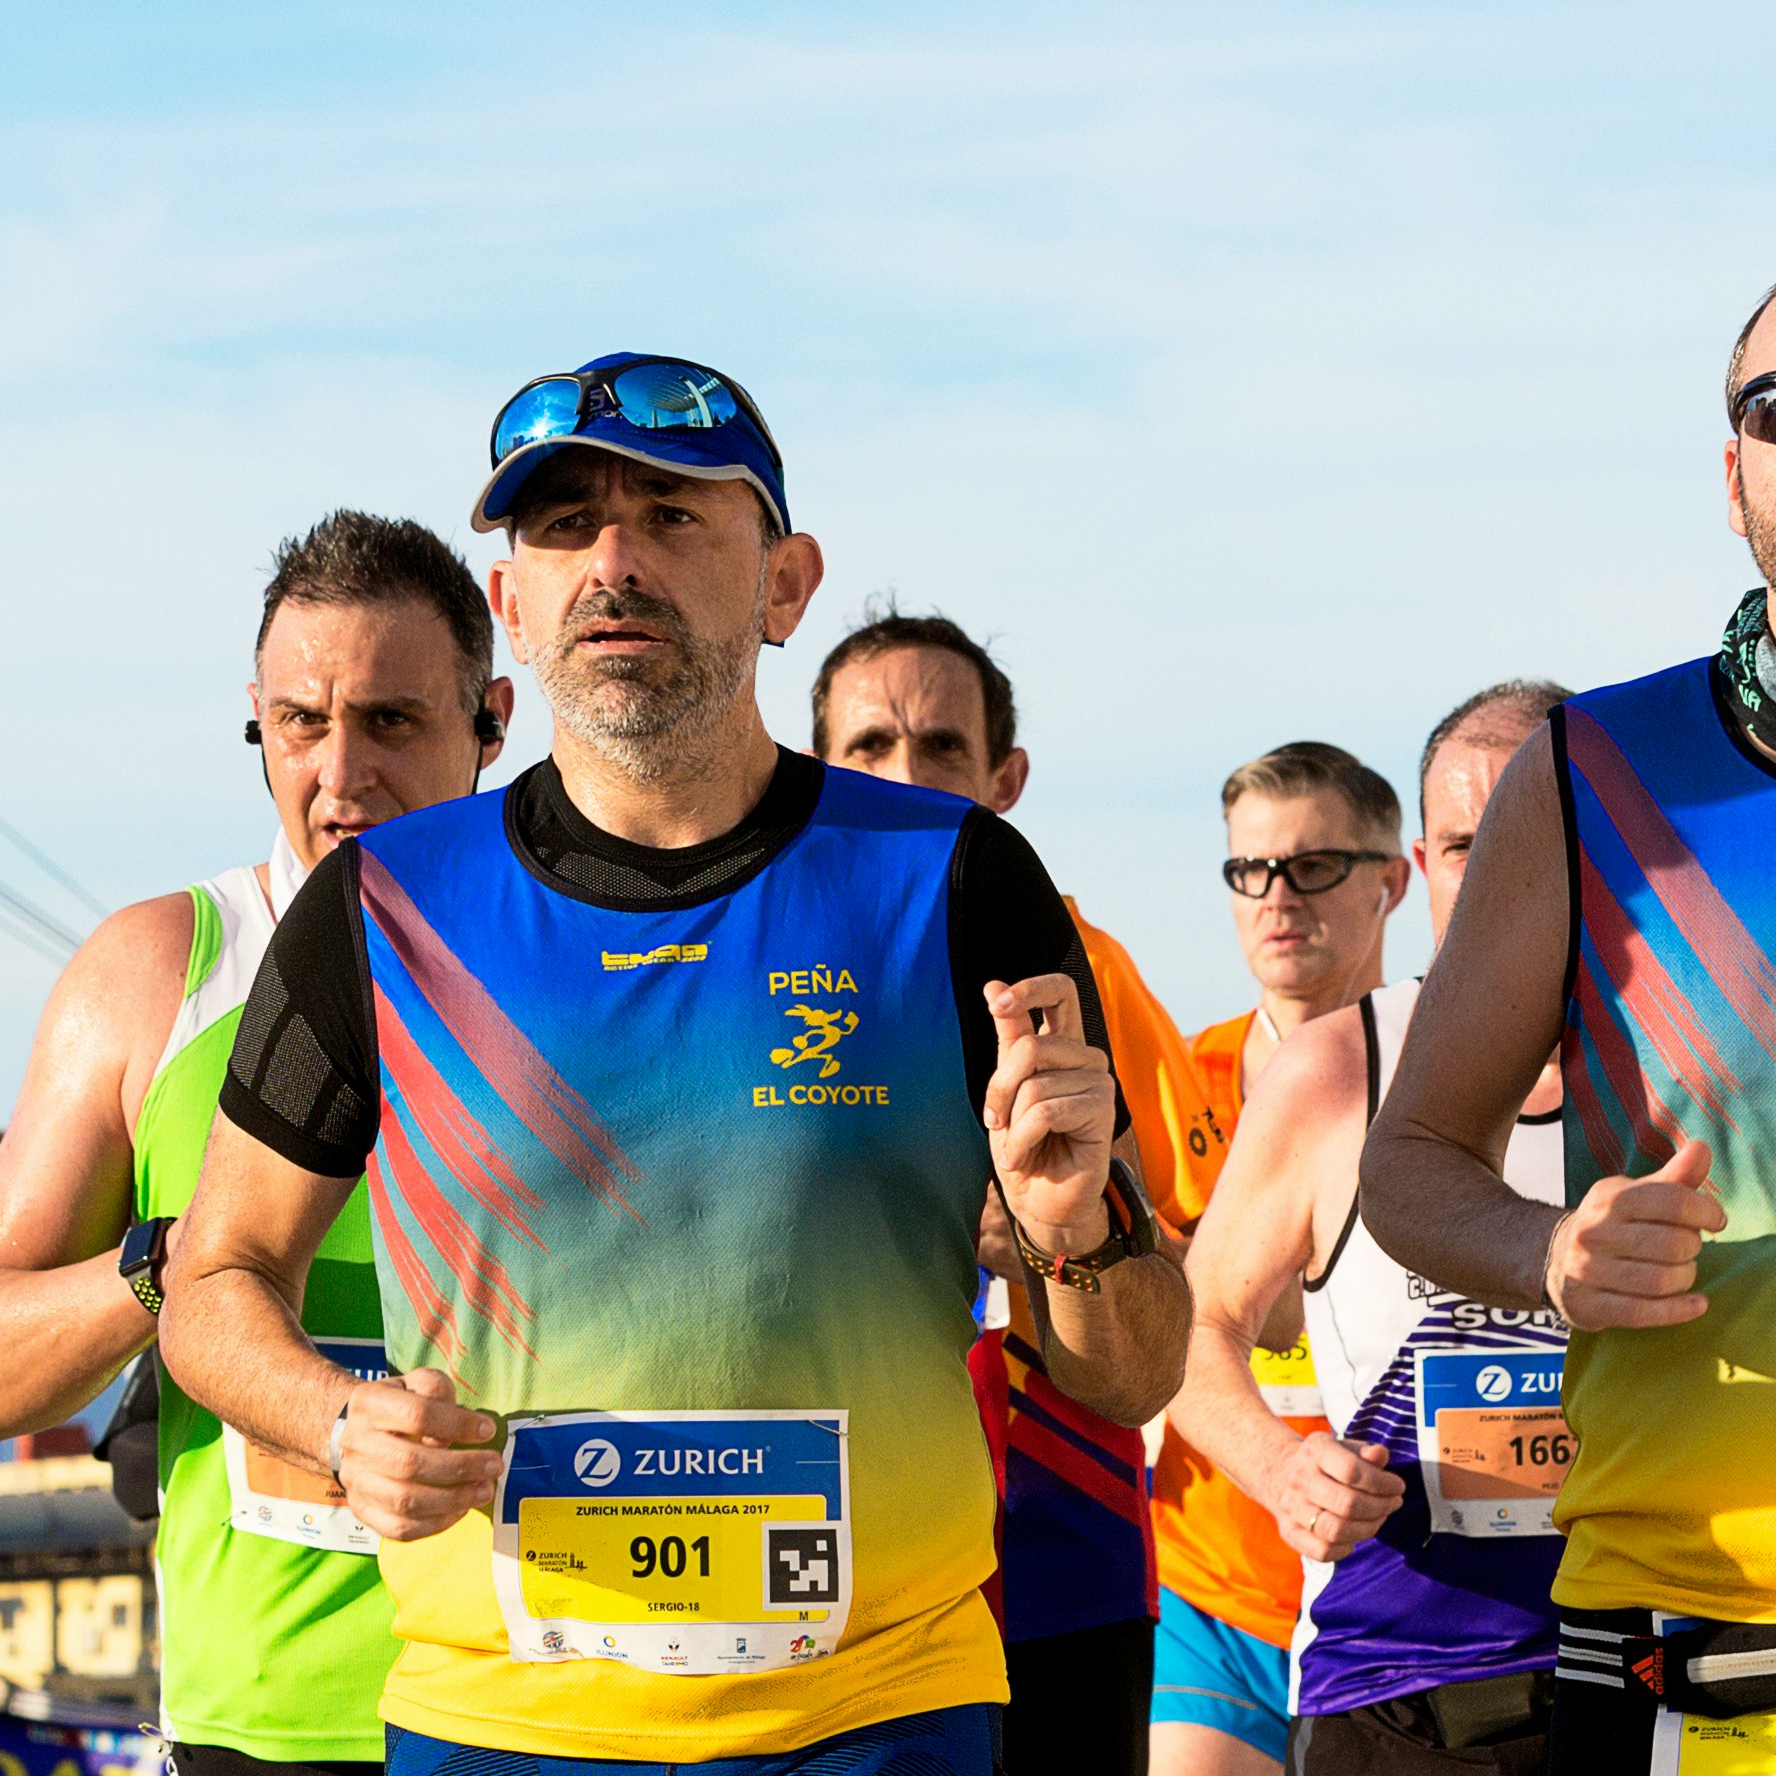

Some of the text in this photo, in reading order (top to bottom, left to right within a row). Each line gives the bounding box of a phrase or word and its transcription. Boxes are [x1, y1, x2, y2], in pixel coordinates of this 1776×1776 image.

[768, 964, 859, 996] PEÑA
[753, 1085, 889, 1107] EL COYOTE
[634, 1447, 764, 1476] ZURICH
[576, 1503, 771, 1516] ZURICH MARATÓN MÁLAGA 2017
[630, 1535, 711, 1578] 901
[647, 1602, 701, 1613] SERGIO-18
[799, 1611, 809, 1621] M
[1654, 1647, 1665, 1696] adidas
